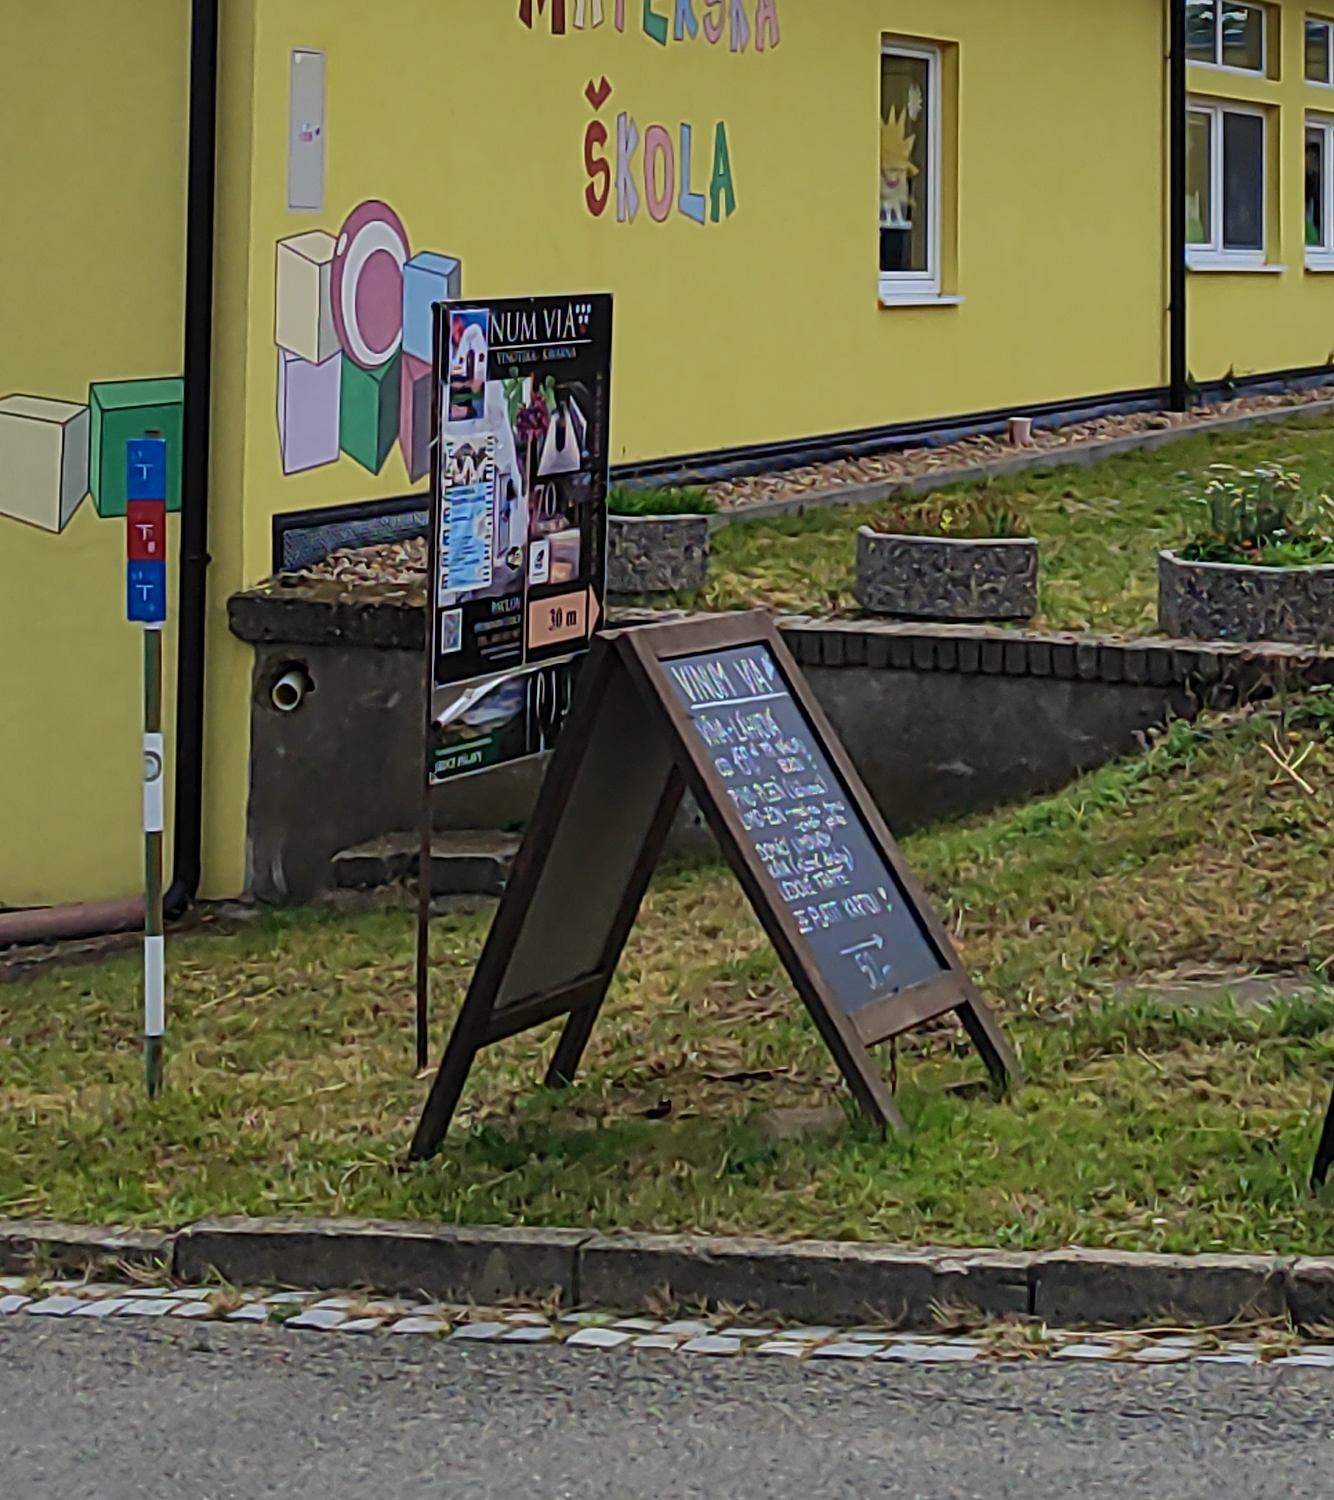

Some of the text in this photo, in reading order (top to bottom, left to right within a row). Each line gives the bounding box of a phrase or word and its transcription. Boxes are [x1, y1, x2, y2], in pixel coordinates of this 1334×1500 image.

[584, 75, 736, 225] ŠKOLA
[543, 302, 577, 339] VIA
[548, 607, 577, 631] 30 m
[672, 661, 736, 701] VINUM
